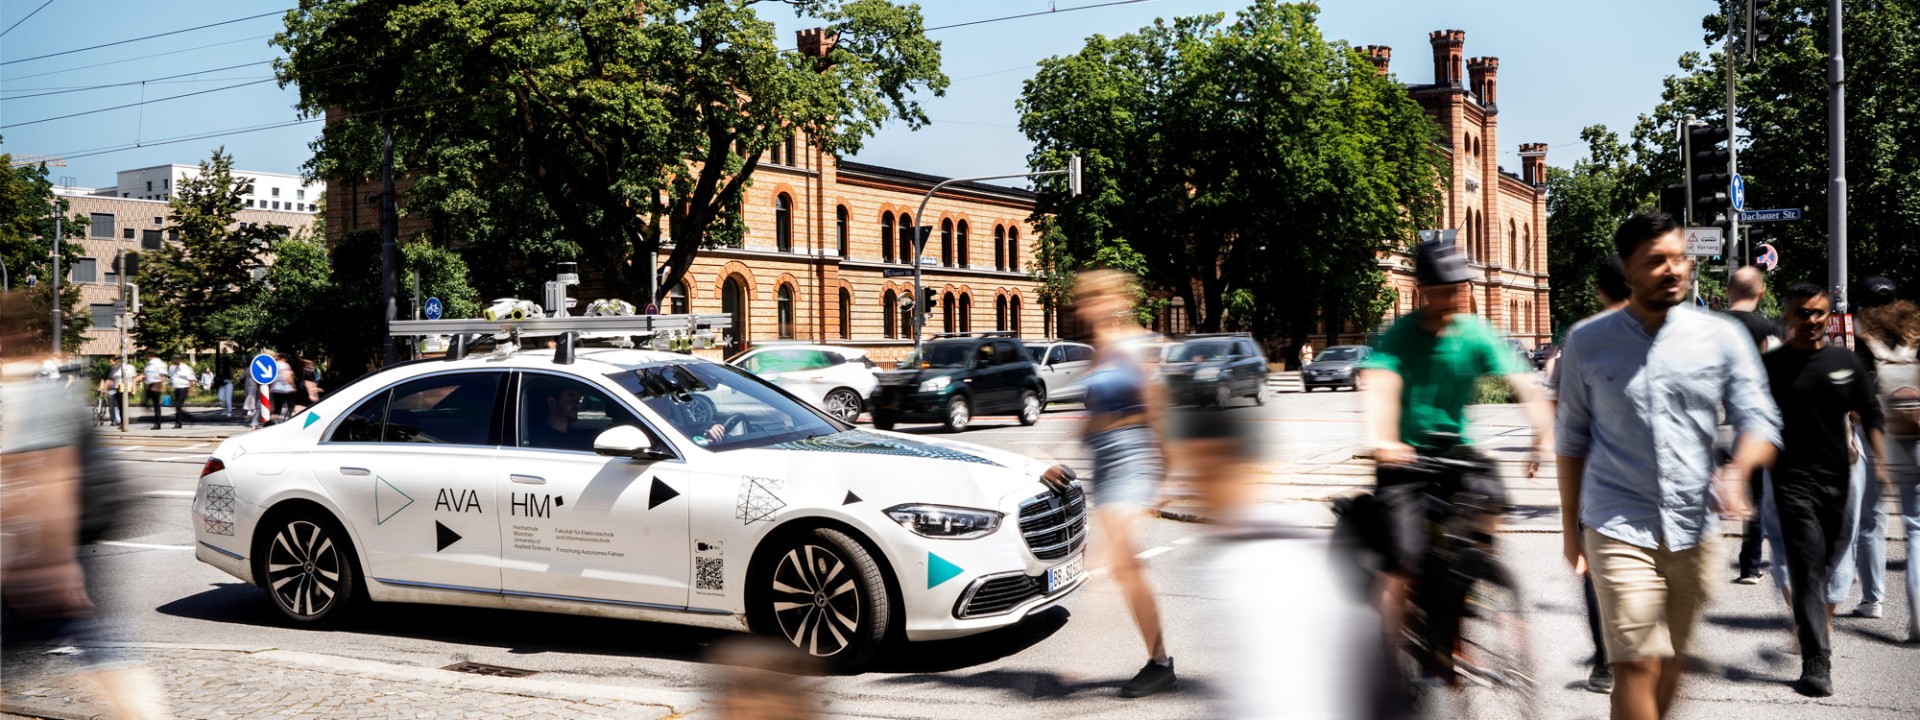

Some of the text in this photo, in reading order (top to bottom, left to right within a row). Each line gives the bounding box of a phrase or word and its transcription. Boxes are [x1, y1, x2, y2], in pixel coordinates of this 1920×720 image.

[1741, 210, 1797, 221] Dachauer Str.
[434, 488, 482, 514] AVA
[512, 492, 550, 518] HM
